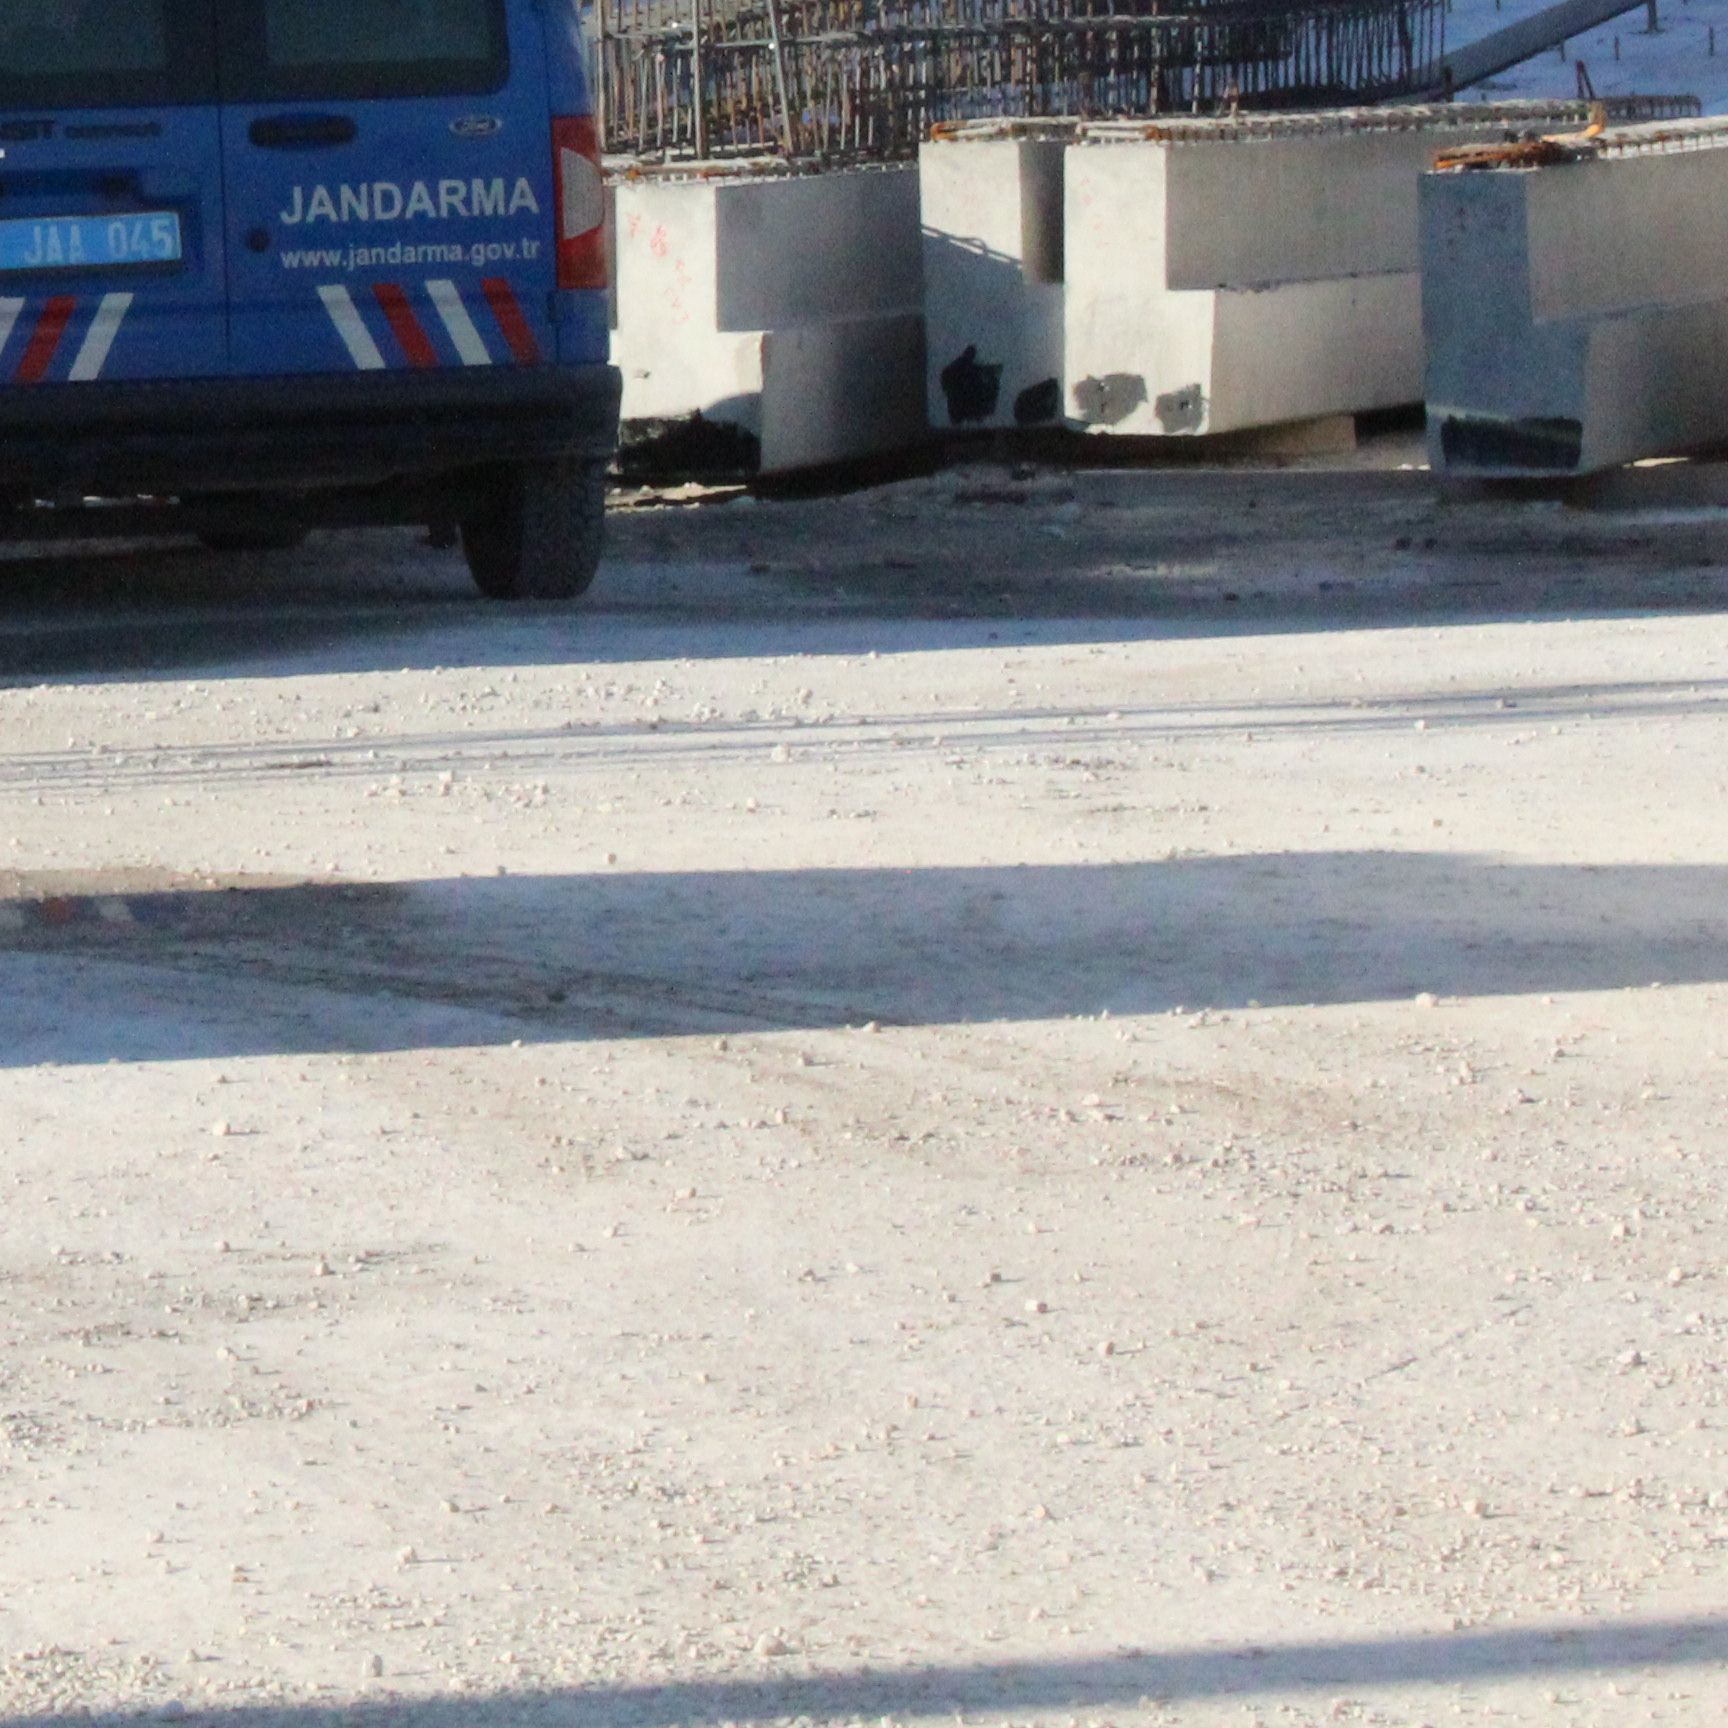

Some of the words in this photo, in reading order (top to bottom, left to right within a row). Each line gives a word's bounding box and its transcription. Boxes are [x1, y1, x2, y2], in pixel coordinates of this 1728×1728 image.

[279, 176, 540, 224] JANDARMA
[24, 224, 85, 264] JAA
[106, 218, 173, 259] 045
[281, 237, 541, 271] www.jandarma.gov.tr
